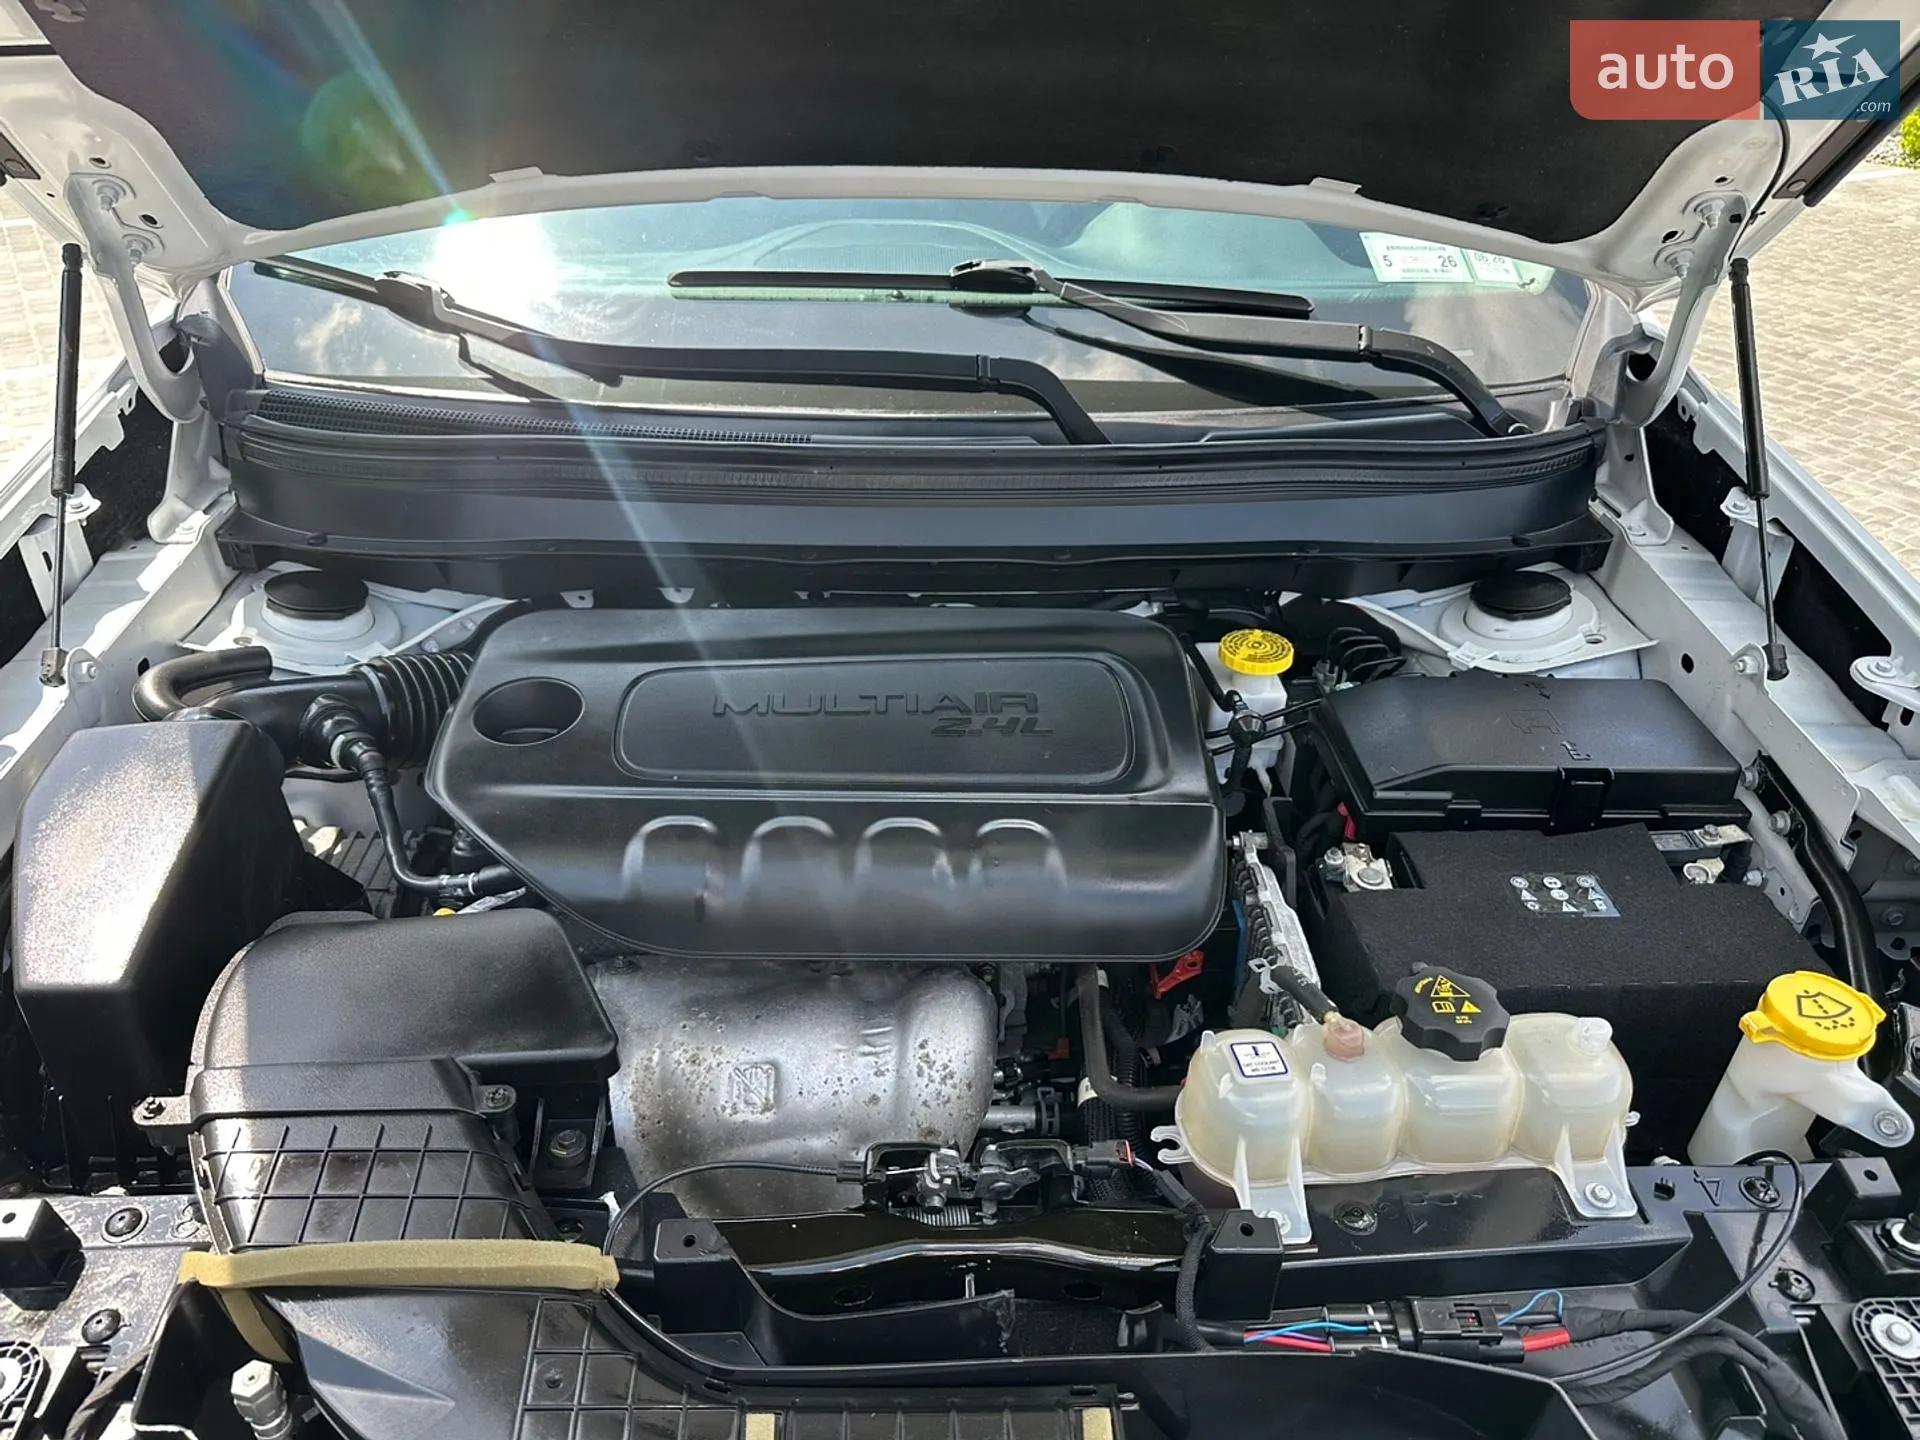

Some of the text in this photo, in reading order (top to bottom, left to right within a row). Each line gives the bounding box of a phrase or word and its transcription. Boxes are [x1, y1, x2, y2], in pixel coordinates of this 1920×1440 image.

[1382, 254, 1458, 268] 5 26
[712, 691, 1039, 717] MULTIAIR
[930, 716, 1054, 738] 2.4L
